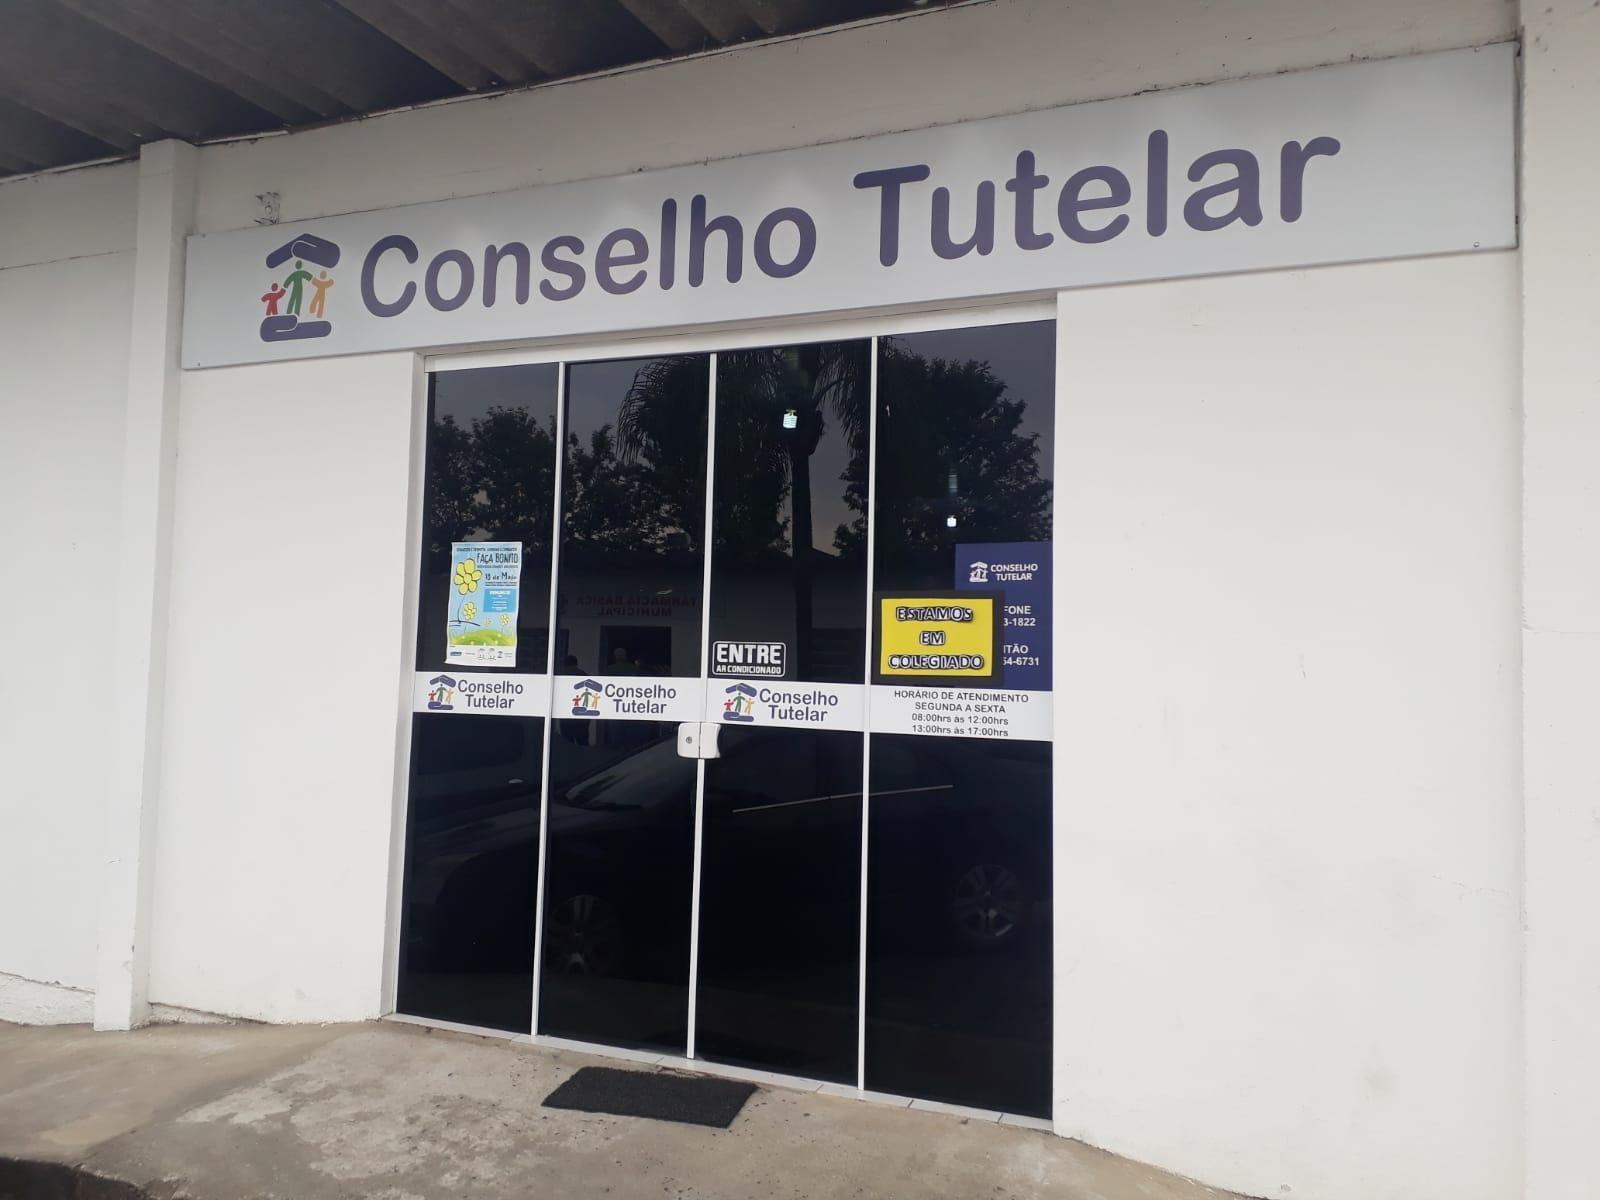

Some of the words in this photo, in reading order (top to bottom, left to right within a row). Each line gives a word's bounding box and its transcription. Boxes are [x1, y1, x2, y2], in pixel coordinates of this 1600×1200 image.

[360, 193, 818, 319] Conselho
[854, 129, 1341, 268] Tutelar
[990, 563, 1038, 573] CONSELHO
[995, 573, 1032, 582] TUTELAR
[896, 606, 973, 622] ESTAMOS
[919, 630, 946, 646] EM
[716, 643, 782, 664] ENTRE
[716, 664, 727, 673] AR
[727, 665, 782, 675] CONDICIONADO
[888, 654, 984, 671] COLEGIADO
[458, 679, 524, 695] Conselho
[604, 683, 677, 699] Conselho
[465, 693, 515, 709] Tutelar
[759, 688, 839, 706] Conselho
[941, 691, 954, 700] DE
[956, 692, 1029, 703] ATENDIMENTO
[613, 699, 667, 714] Tutelar
[768, 704, 828, 722] Tutelar
[915, 702, 963, 712] SEGUNDA
[964, 704, 972, 712] A
[974, 704, 1006, 713] SEXTA
[912, 713, 951, 723] 08:00hrs
[968, 715, 1009, 725] 12:00hrs
[912, 724, 951, 734] 13:00hrs
[968, 727, 1009, 737] 17:00hrs
